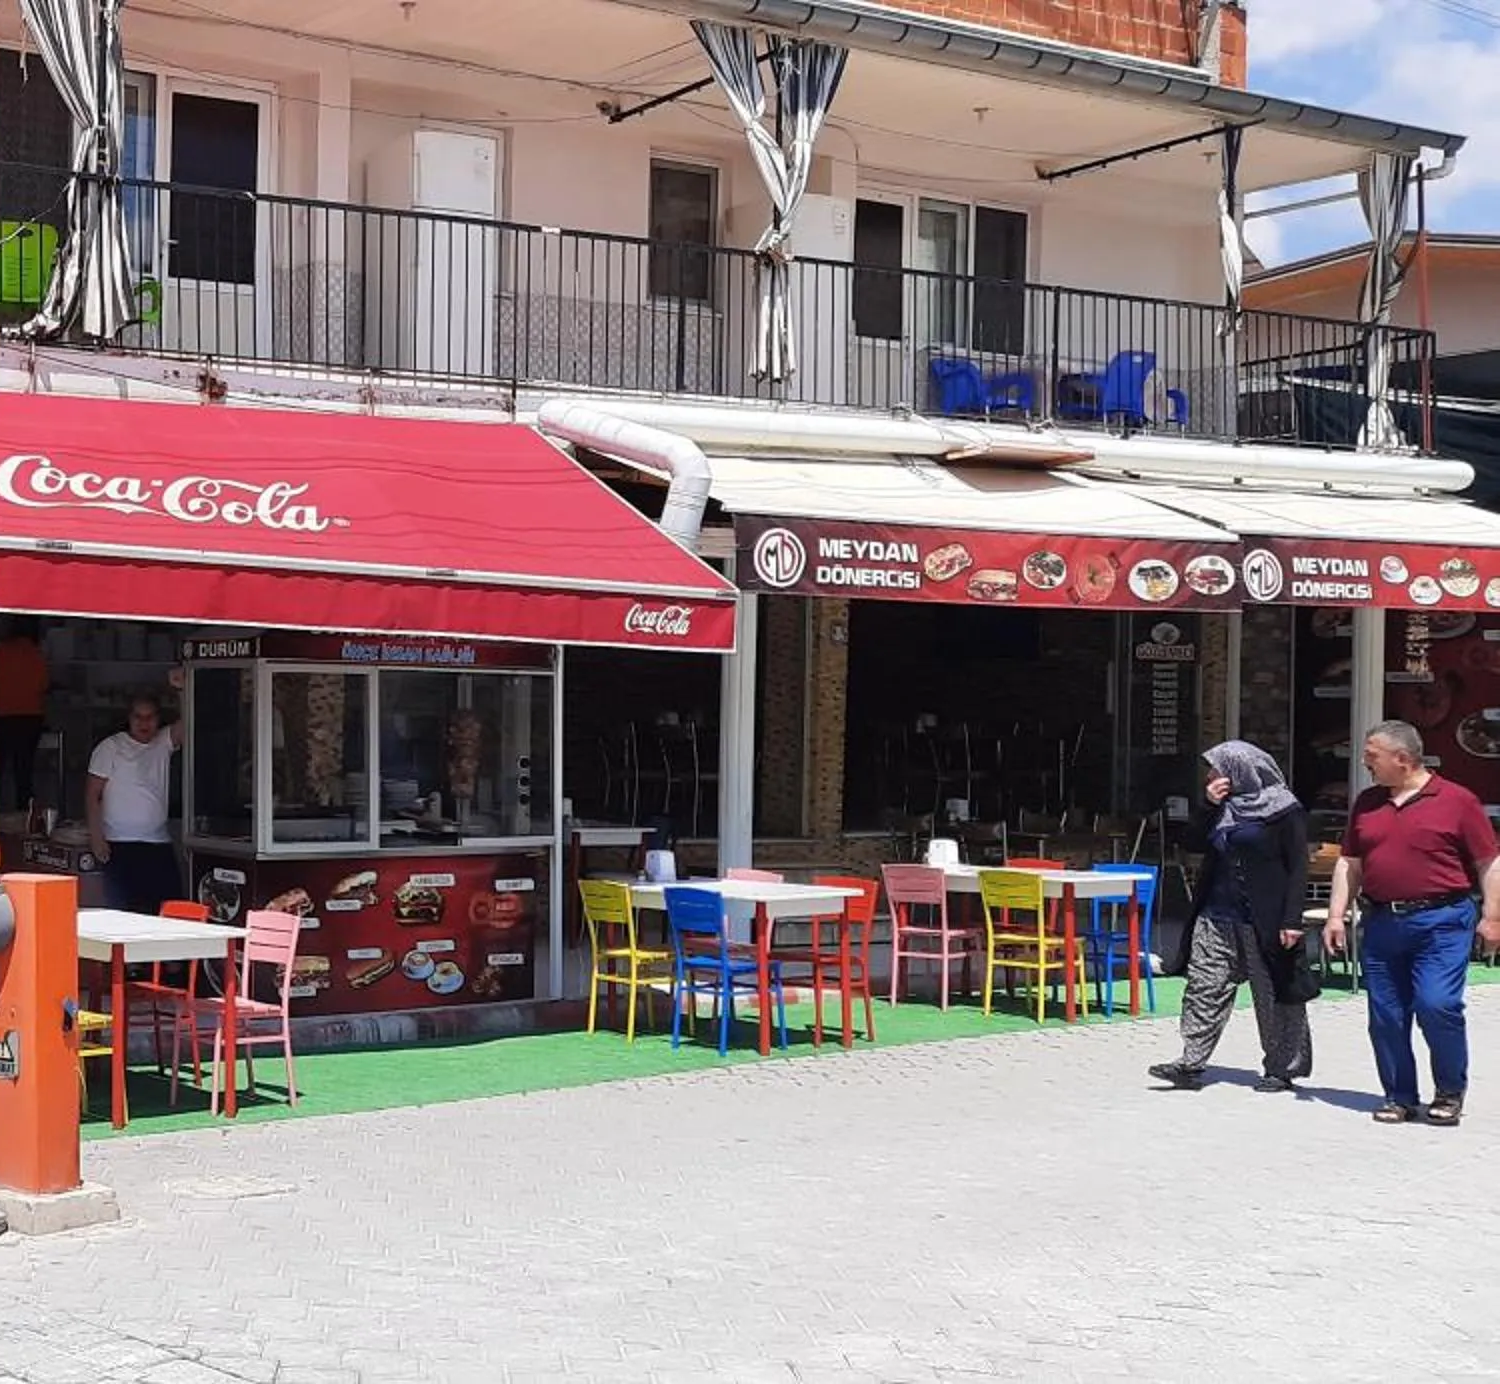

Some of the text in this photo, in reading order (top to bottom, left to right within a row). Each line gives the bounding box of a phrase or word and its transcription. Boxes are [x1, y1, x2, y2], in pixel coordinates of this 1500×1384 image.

[818, 537, 919, 564] MEYDAN
[816, 566, 921, 589] DÖNERCİSİ
[1292, 557, 1369, 577] MEYDAN
[624, 602, 695, 636] Coca-Cola
